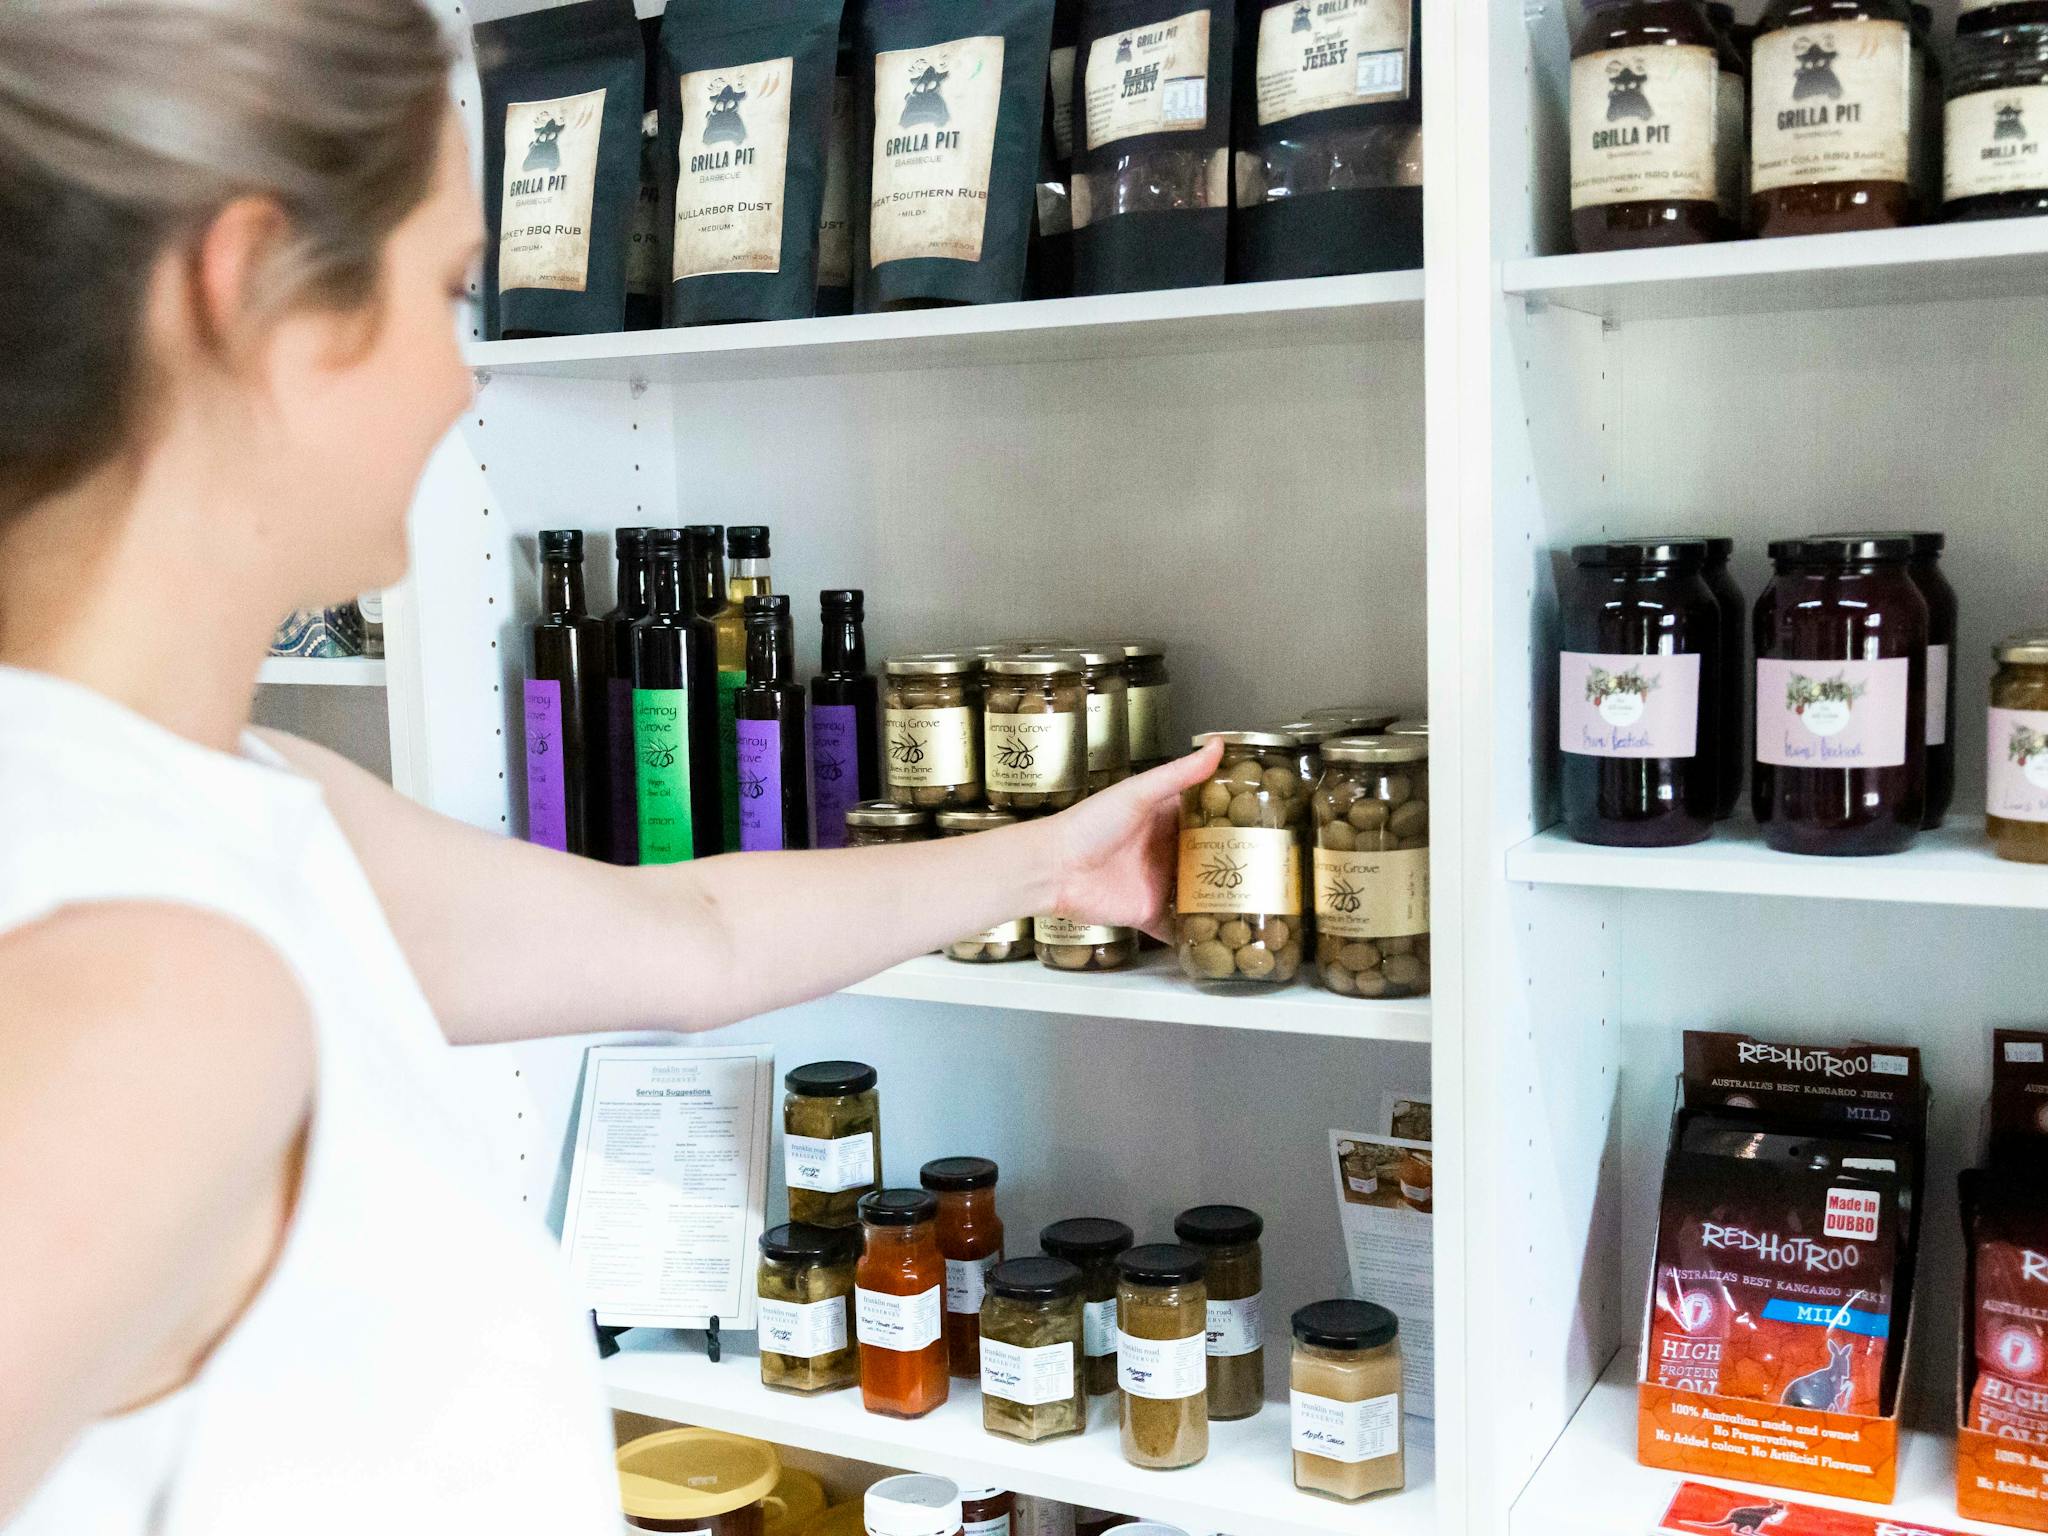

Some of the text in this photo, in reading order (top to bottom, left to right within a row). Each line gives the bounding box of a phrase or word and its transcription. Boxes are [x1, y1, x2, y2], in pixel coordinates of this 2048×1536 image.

[1137, 26, 1178, 48] GRILLA PIT
[1303, 48, 1348, 71] JERKY
[1121, 76, 1158, 98] JERKY
[1777, 103, 1861, 130] GRILLA PIT
[886, 131, 960, 157] GRILLA PIT
[1593, 125, 1670, 150] GRILLA PIT
[691, 147, 755, 173] GRILLA PIT
[510, 175, 567, 197] GRILLA PIT
[893, 188, 987, 202] SOUTHERN RUB
[678, 202, 773, 222] NULLARBOR DUST
[526, 225, 551, 236] BBQ
[555, 225, 582, 236] RUB
[908, 717, 940, 729] Grove
[1018, 722, 1051, 734] Grove
[1343, 862, 1379, 874] Grove
[1068, 921, 1091, 932] Brine
[636, 1088, 712, 1097] Serving Suggestions
[1711, 1078, 1894, 1100] AUSTRALIA'S BEST KANGAROO JERKY
[1846, 1106, 1891, 1122] MILD
[1828, 1195, 1876, 1213] Made in
[1826, 1213, 1875, 1234] DUBBO
[1666, 1269, 1888, 1304] AUSTRALIA'S BEST KANGAROO JERKY
[1797, 1305, 1851, 1327] MILD
[1662, 1338, 1721, 1361] HIGH
[1659, 1364, 1718, 1380] PROTEIN
[1671, 1402, 1860, 1443] 100% Australian made and owned
[1302, 1430, 1324, 1441] Apple
[1713, 1423, 1809, 1451] No Preservatives,
[1656, 1428, 1671, 1442] No
[1673, 1432, 1710, 1449] Added
[1711, 1440, 1748, 1457] colour,
[1751, 1444, 1768, 1459] No
[1769, 1448, 1819, 1468] Artificial
